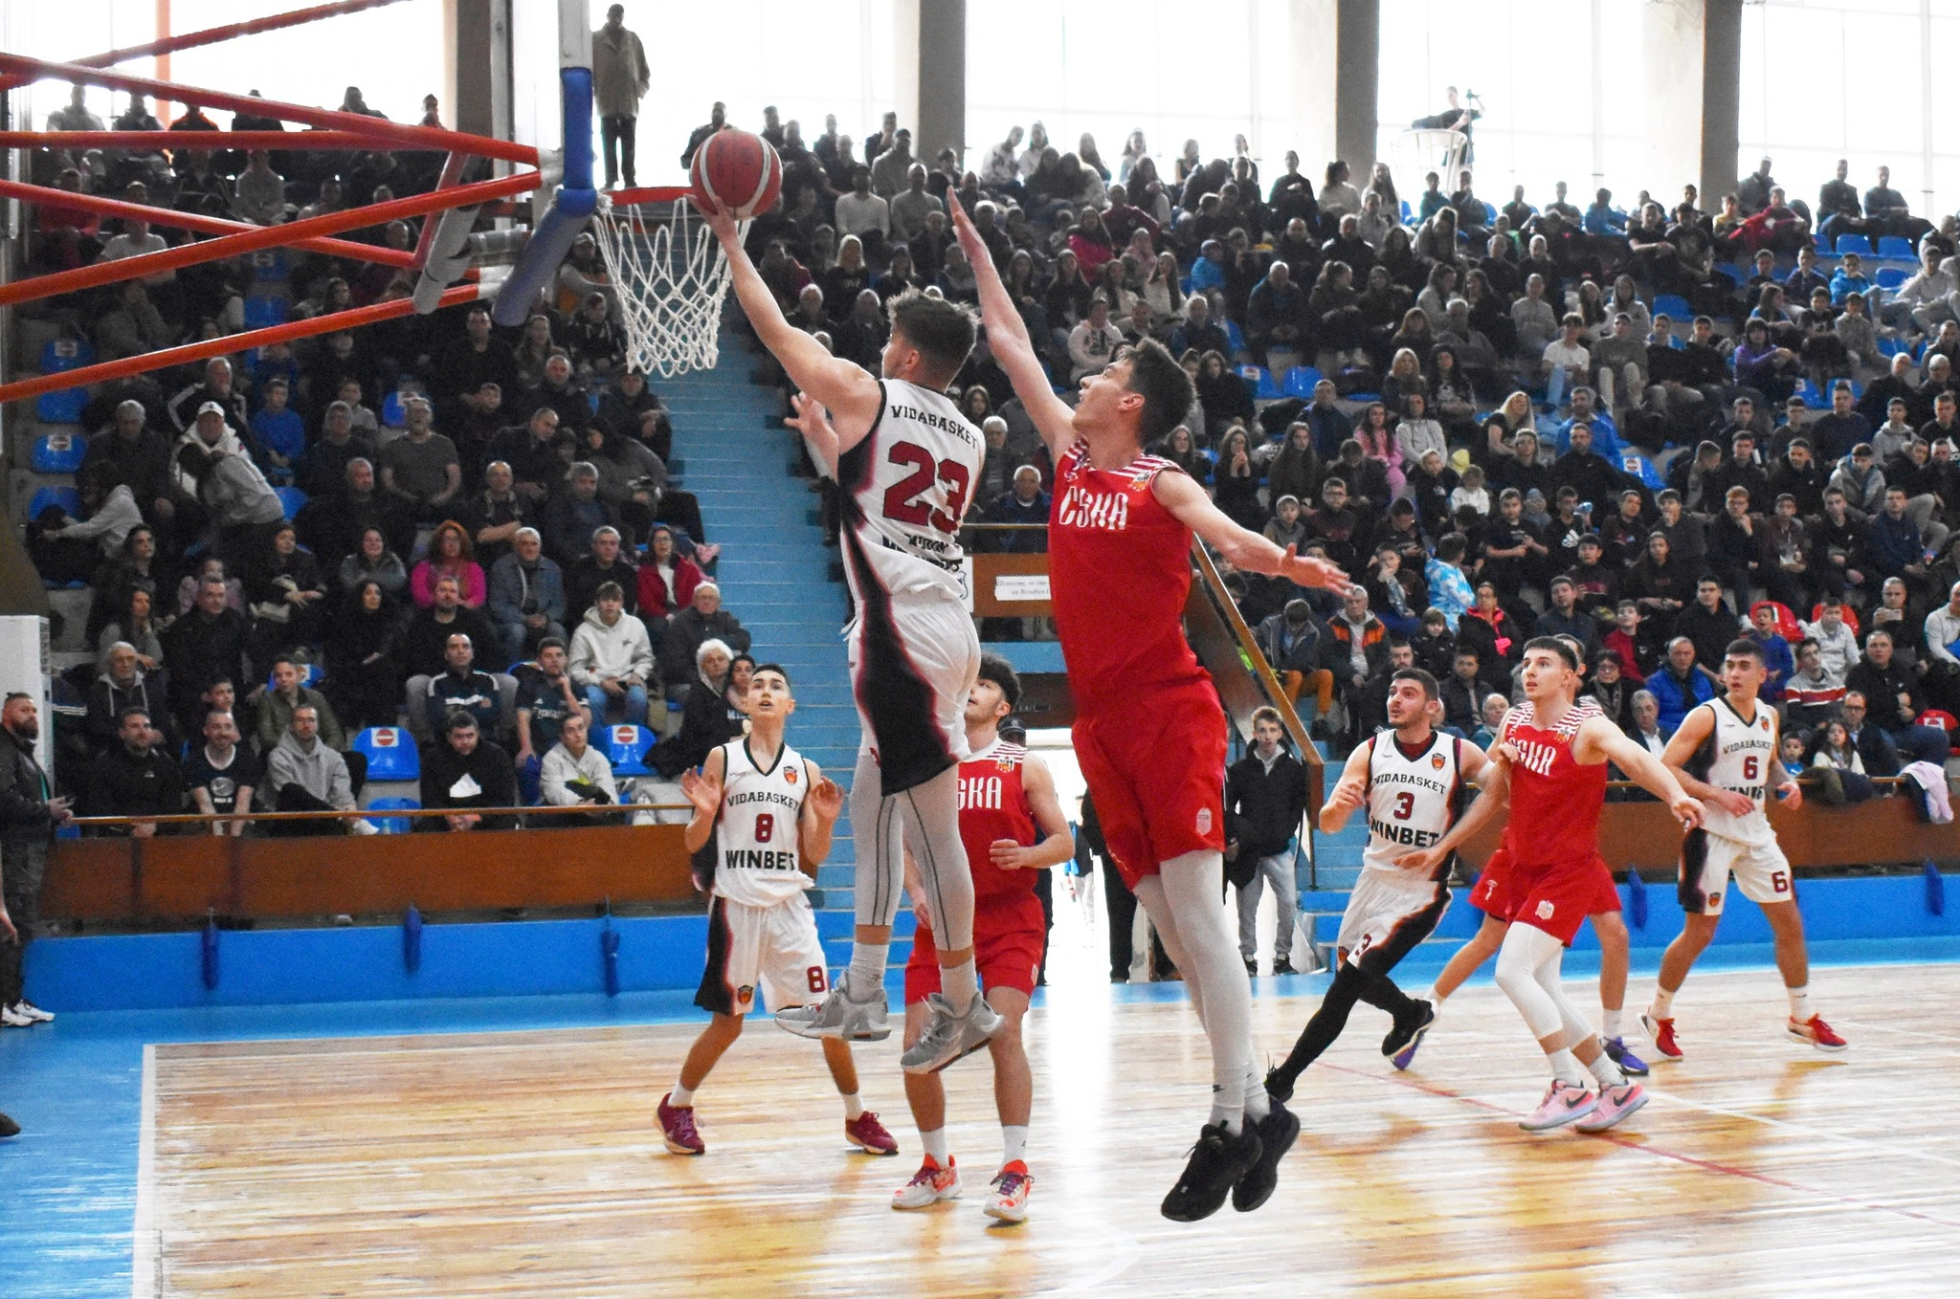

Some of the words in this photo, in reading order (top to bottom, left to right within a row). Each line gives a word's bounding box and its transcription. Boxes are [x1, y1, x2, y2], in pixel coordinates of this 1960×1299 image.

[890, 405, 977, 450] VIDABASKET
[883, 440, 970, 535] 23
[1059, 486, 1129, 530] CSKA
[1743, 755, 1759, 780] 6
[957, 776, 1002, 811] SKA
[1374, 773, 1447, 795] VIDABASKET
[727, 791, 800, 811] VIDABASKET
[1393, 791, 1415, 820] 3
[754, 813, 774, 844] 8
[1771, 870, 1789, 894] 6
[806, 965, 826, 993] 8
